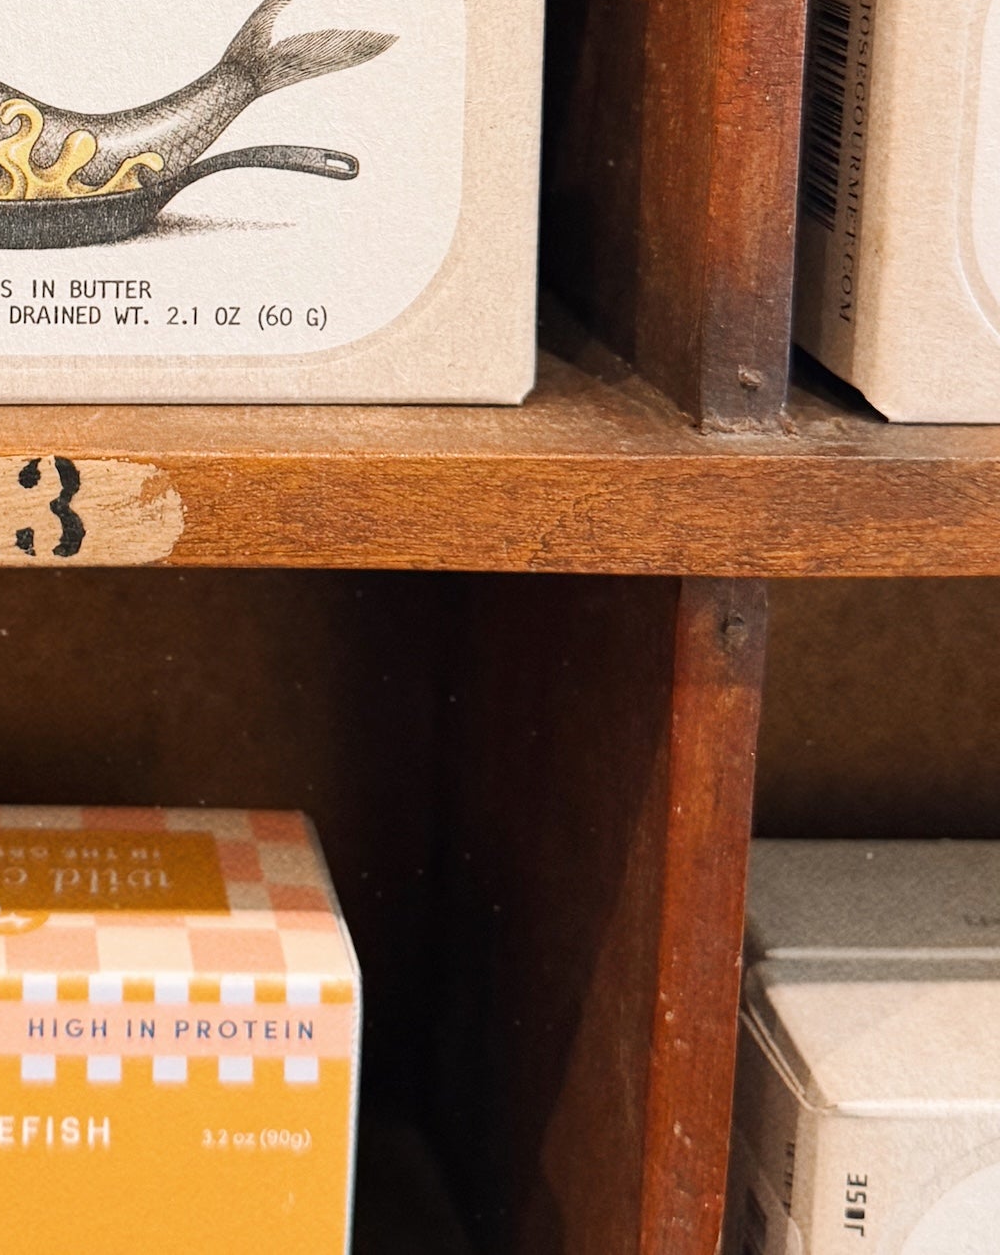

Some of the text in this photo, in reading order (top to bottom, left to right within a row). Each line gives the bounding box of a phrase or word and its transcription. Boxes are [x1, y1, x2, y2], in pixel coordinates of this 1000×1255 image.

[31, 279, 55, 298] IN
[70, 279, 152, 299] BUTTER
[9, 305, 102, 325] DRAINED
[114, 306, 150, 325] WT.
[166, 306, 199, 326] 2.1
[215, 307, 242, 326] OZ
[257, 304, 293, 331] (60
[306, 305, 328, 331] G)
[50, 866, 172, 895] wild
[28, 1018, 314, 1041] HIGH IN PROTEIN
[201, 1128, 312, 1153] 3.2 oz (90g)
